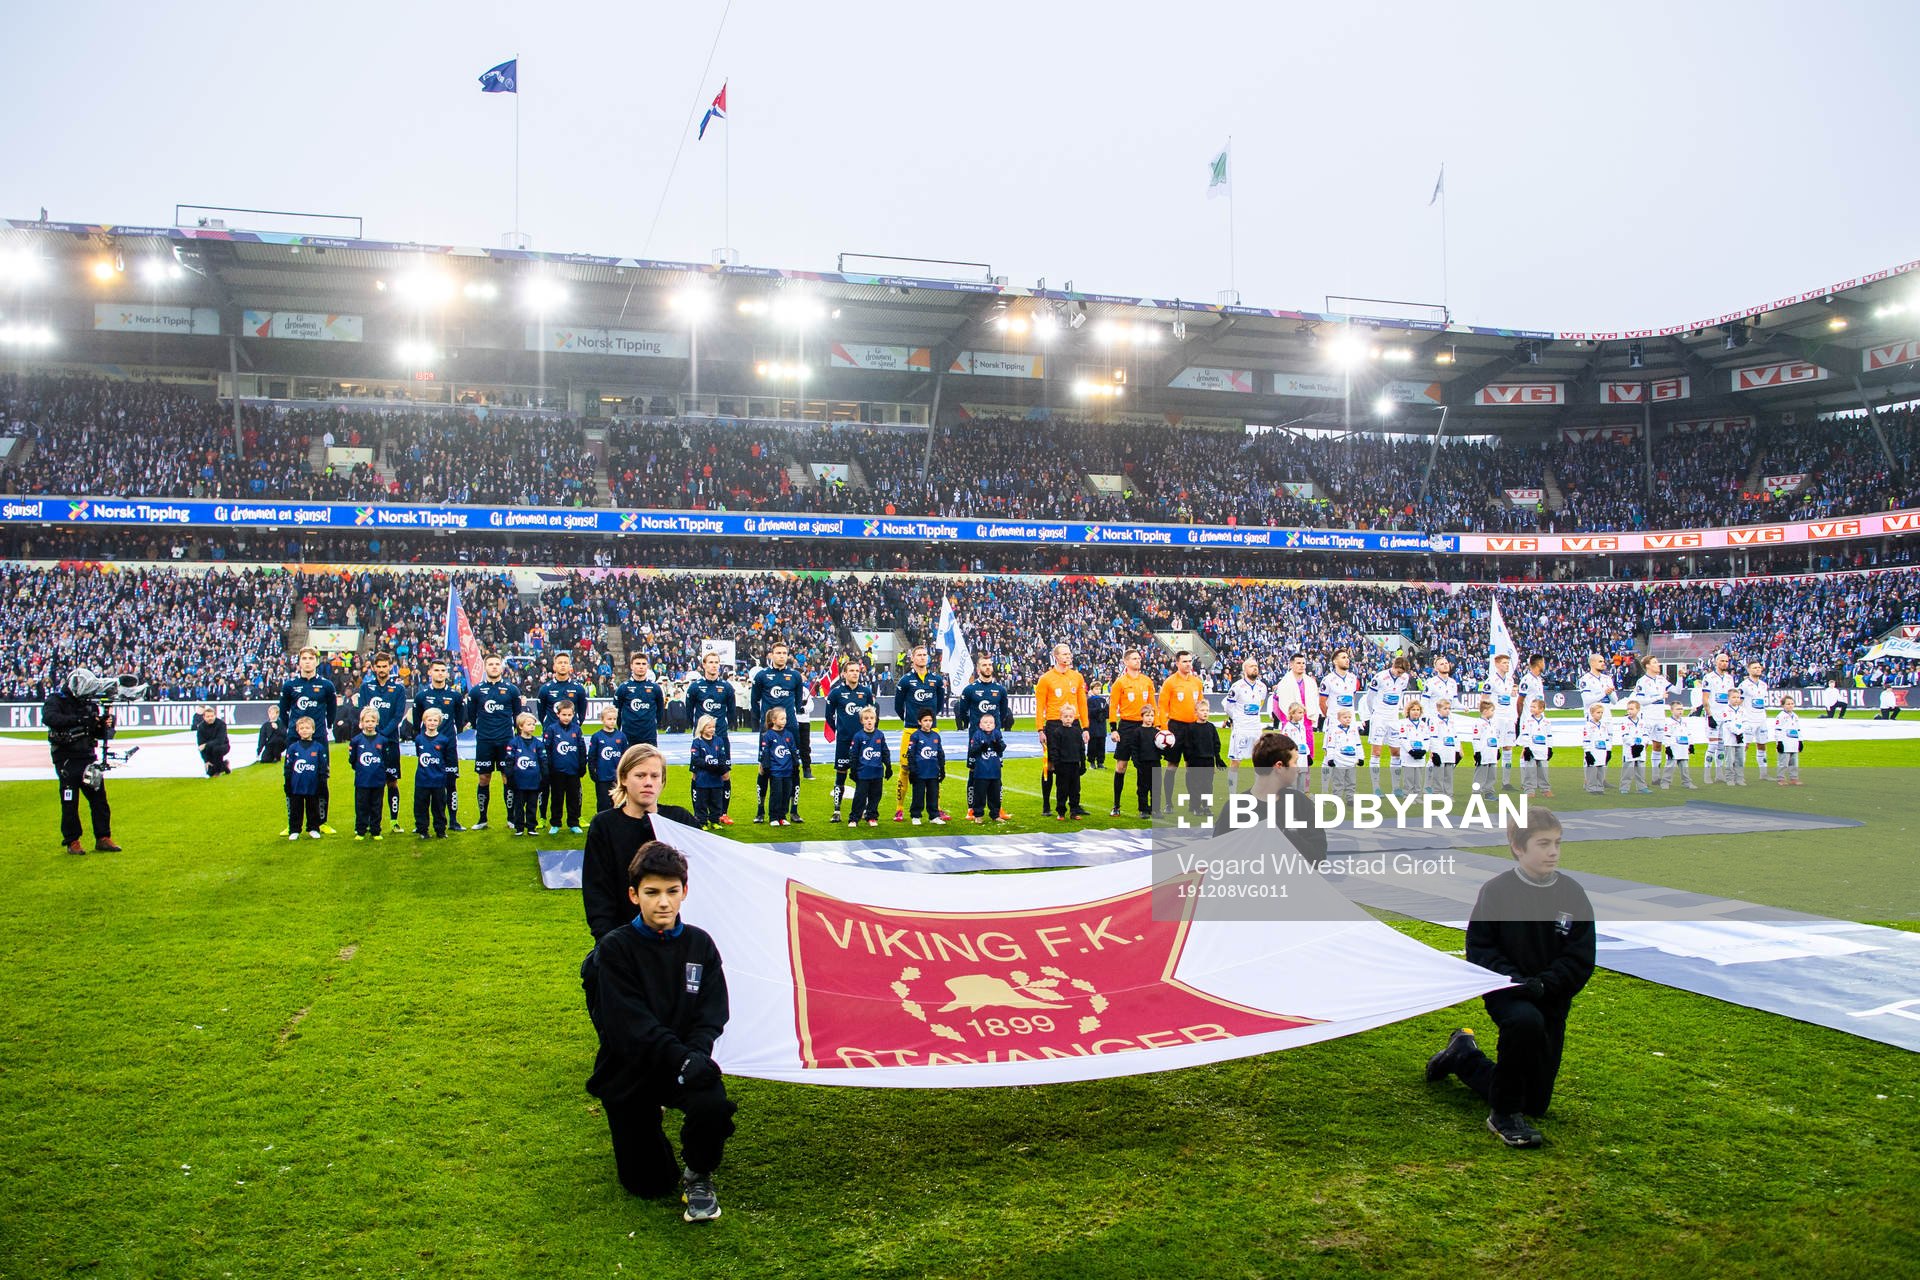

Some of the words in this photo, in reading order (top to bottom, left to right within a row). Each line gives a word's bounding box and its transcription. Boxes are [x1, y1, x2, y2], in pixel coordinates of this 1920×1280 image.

[1863, 271, 1887, 283] VG
[1832, 280, 1855, 292] VG
[1802, 289, 1824, 300] VG
[1774, 297, 1796, 308] VG
[1747, 304, 1767, 316] VG
[136, 315, 160, 326] Norsk
[162, 317, 195, 329] Tipping
[1721, 312, 1742, 323] VG
[1660, 326, 1682, 335] VG
[1692, 320, 1714, 330] VG
[577, 336, 613, 349] Norsk
[615, 338, 661, 354] Tipping
[1000, 362, 1024, 371] Tipping
[1743, 365, 1814, 386] VG
[1487, 386, 1552, 402] VG
[1613, 383, 1677, 401] VG
[1770, 476, 1801, 486] VG
[1509, 490, 1537, 498] VG
[3, 501, 42, 518] sjanse!
[94, 505, 135, 518] Norsk
[137, 505, 190, 522] Tipping
[214, 507, 228, 521] Gi
[231, 506, 276, 520] drømmen
[279, 511, 292, 521] en
[294, 508, 330, 525] sjanse!
[379, 511, 416, 524] Norsk
[419, 512, 467, 527] Tipping
[490, 512, 502, 526] Gi
[506, 513, 547, 526] drømmen
[550, 516, 561, 526] en
[564, 514, 598, 529] sjanse!
[641, 516, 675, 529] Norsk
[678, 517, 723, 533] Tipping
[744, 518, 755, 531] Gi
[758, 518, 797, 531] drømmen
[799, 522, 809, 532] en
[812, 520, 843, 535] sjanse!
[883, 522, 916, 535] Norsk
[919, 524, 957, 538] Tipping
[1810, 523, 1859, 539] VG
[976, 525, 987, 537] Gi
[990, 525, 1024, 538] drømmen
[1026, 528, 1037, 538] en
[1038, 526, 1066, 541] sjanse!
[1103, 529, 1132, 541] Norsk
[1135, 530, 1171, 543] Tipping
[1188, 531, 1199, 543] Gi
[1200, 531, 1231, 543] drømmen
[1233, 534, 1243, 543] en
[1244, 532, 1270, 545] sjanse!
[1729, 529, 1784, 545] VG
[1302, 535, 1331, 547] Norsk
[1333, 536, 1365, 549] Tipping
[1380, 536, 1389, 548] Gi
[1488, 539, 1537, 550] VG
[1563, 538, 1618, 550] VG
[1645, 535, 1700, 548] VG
[1903, 627, 1920, 637] V
[774, 689, 790, 699] Lyse
[917, 691, 933, 701] Lyse
[1850, 690, 1865, 707] FK
[300, 699, 317, 710] Lyse
[372, 700, 391, 710] Lyse
[489, 701, 505, 712] Lyse
[707, 702, 722, 712] Lyse
[981, 702, 997, 712] Lyse
[11, 707, 30, 728] FK
[154, 706, 195, 726] VIKI
[561, 744, 577, 756] Lyse
[605, 749, 621, 760] Lyse
[866, 750, 881, 760] Lyse
[925, 749, 938, 759] Lyse
[365, 754, 381, 766] Lyse
[423, 754, 440, 767] Lyse
[299, 760, 315, 773] Lyse
[816, 912, 1028, 962] VIKING
[1037, 916, 1145, 957] F.K.
[967, 1015, 1055, 1038] 1899
